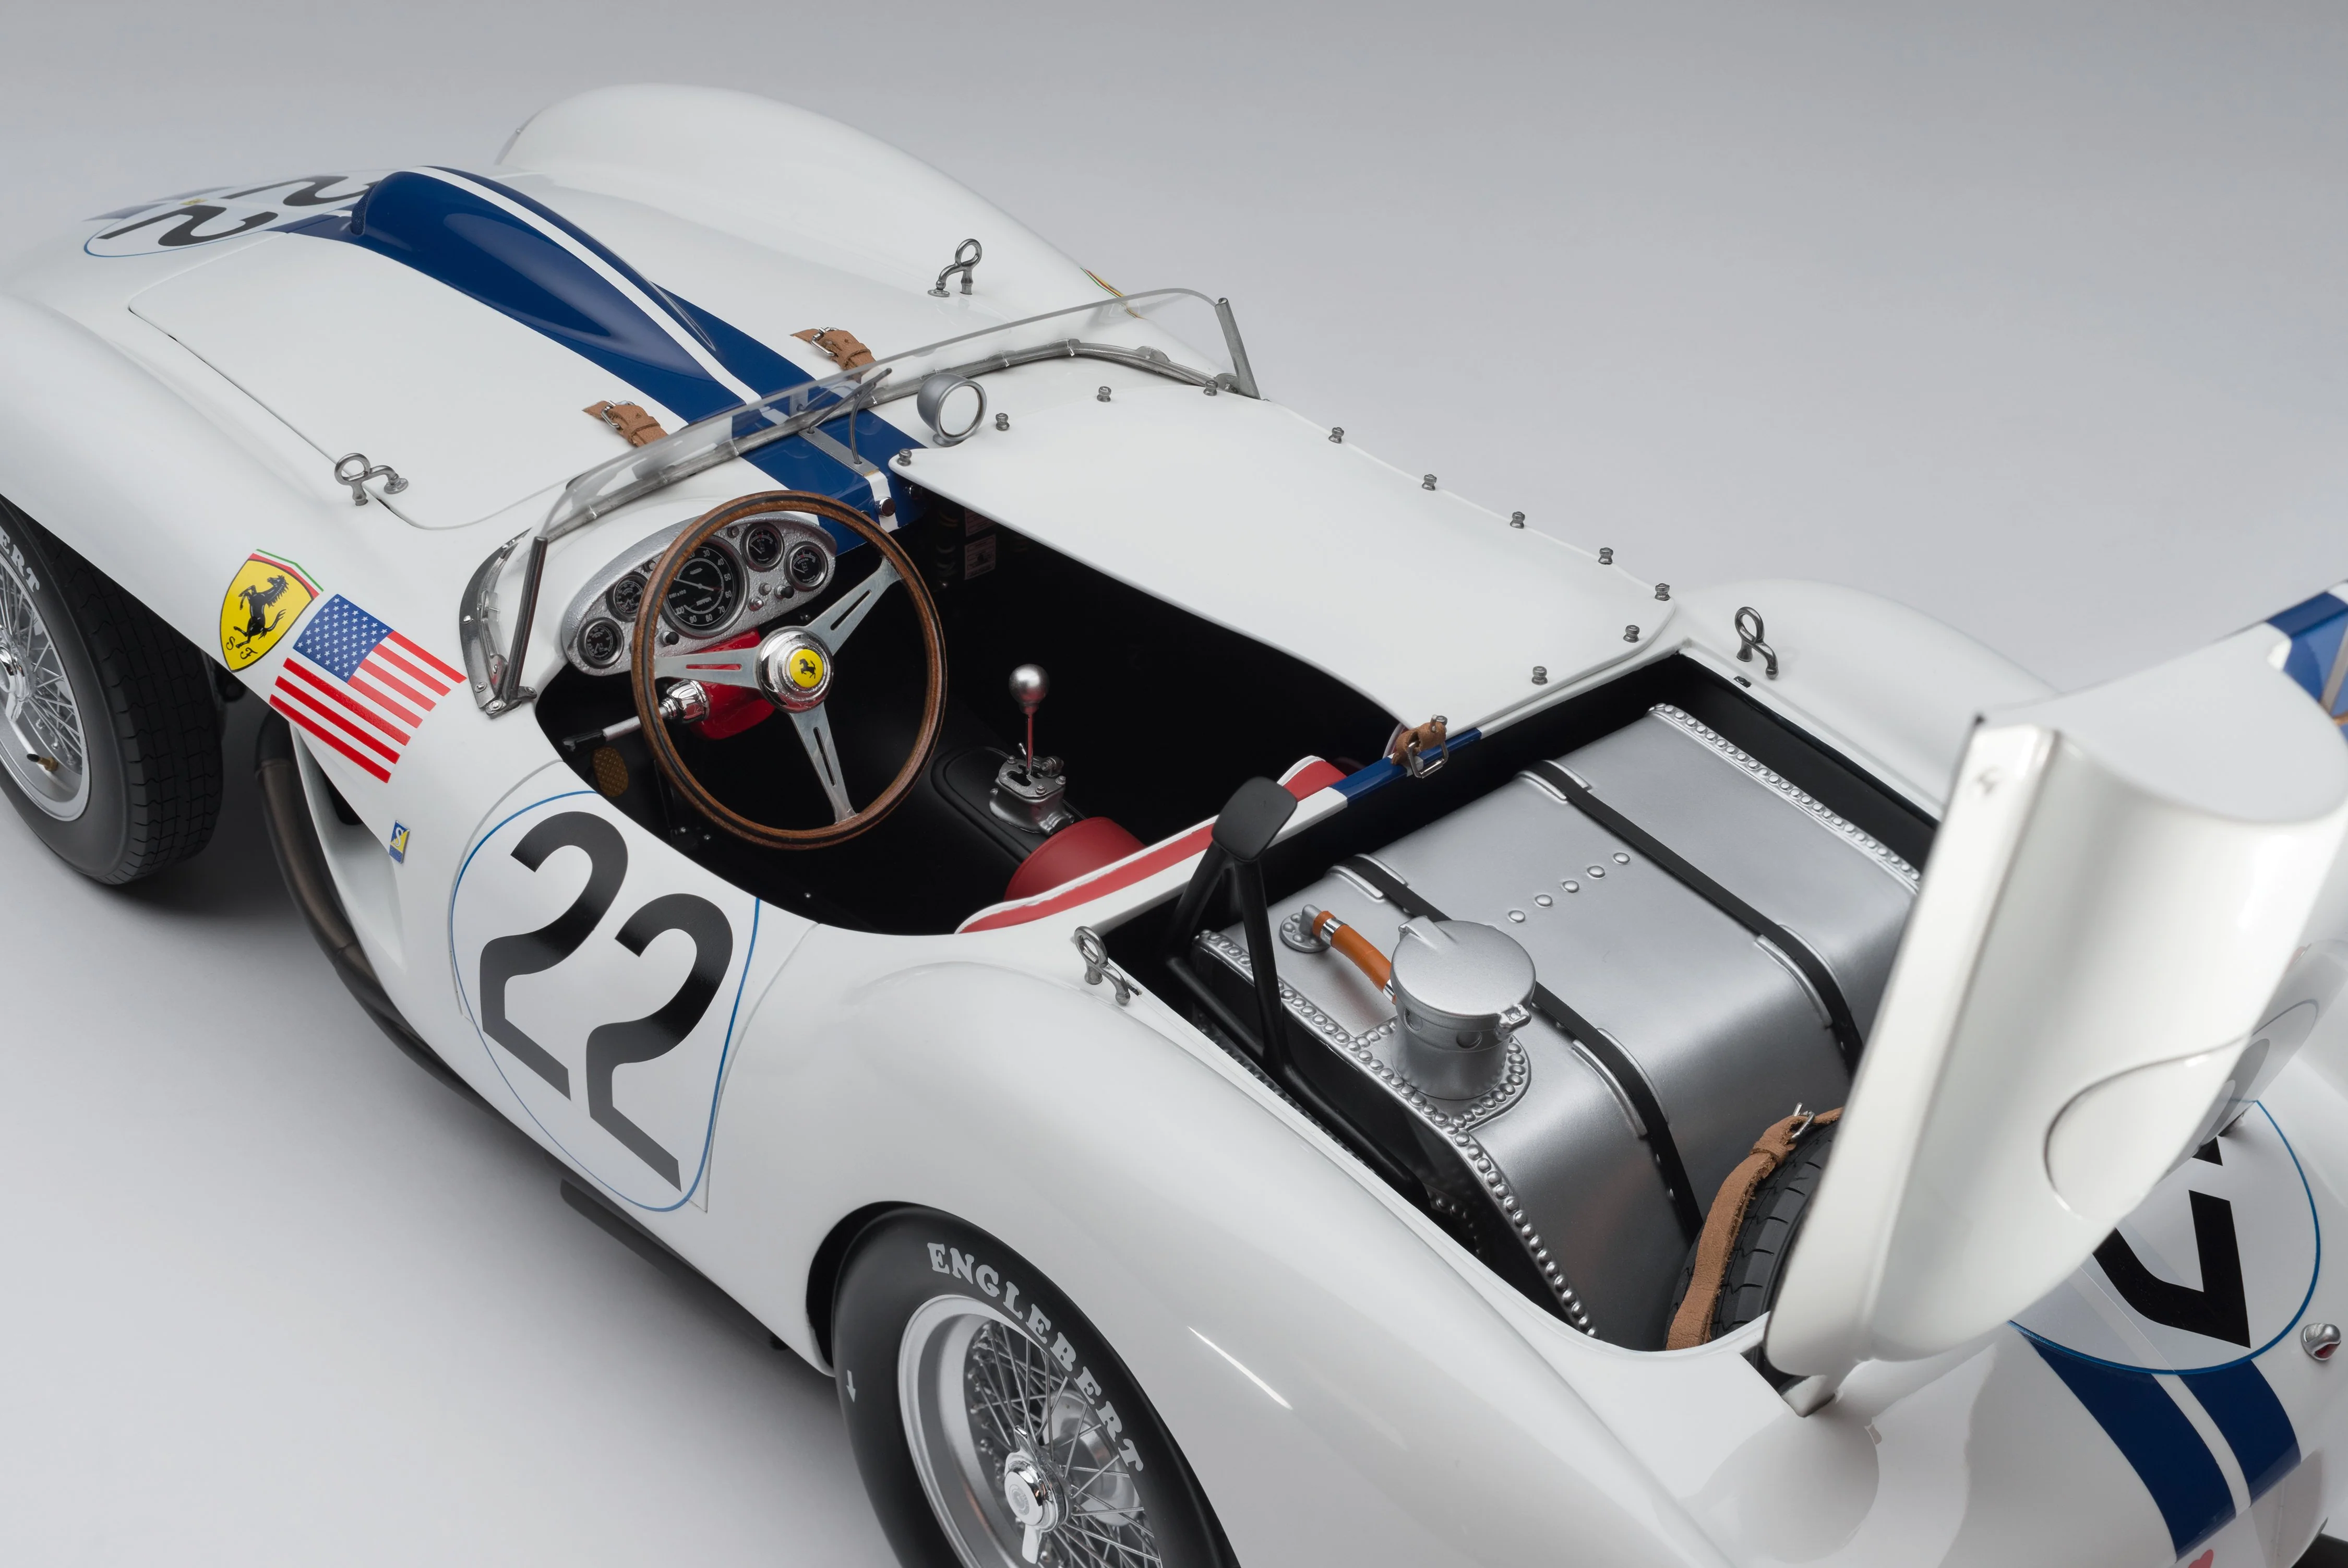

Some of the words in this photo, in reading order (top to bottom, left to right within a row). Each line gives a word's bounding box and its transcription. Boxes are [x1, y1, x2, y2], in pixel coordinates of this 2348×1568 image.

[717, 558, 724, 566] 40
[724, 573, 731, 581] 50
[725, 590, 732, 599] 60
[675, 606, 685, 615] 100
[689, 615, 697, 624] 90
[705, 614, 713, 622] 80
[226, 636, 235, 650] S
[240, 647, 258, 660] F
[393, 827, 404, 847] S
[480, 811, 734, 1193] 22
[927, 1242, 1144, 1471] ENGLEBERT
